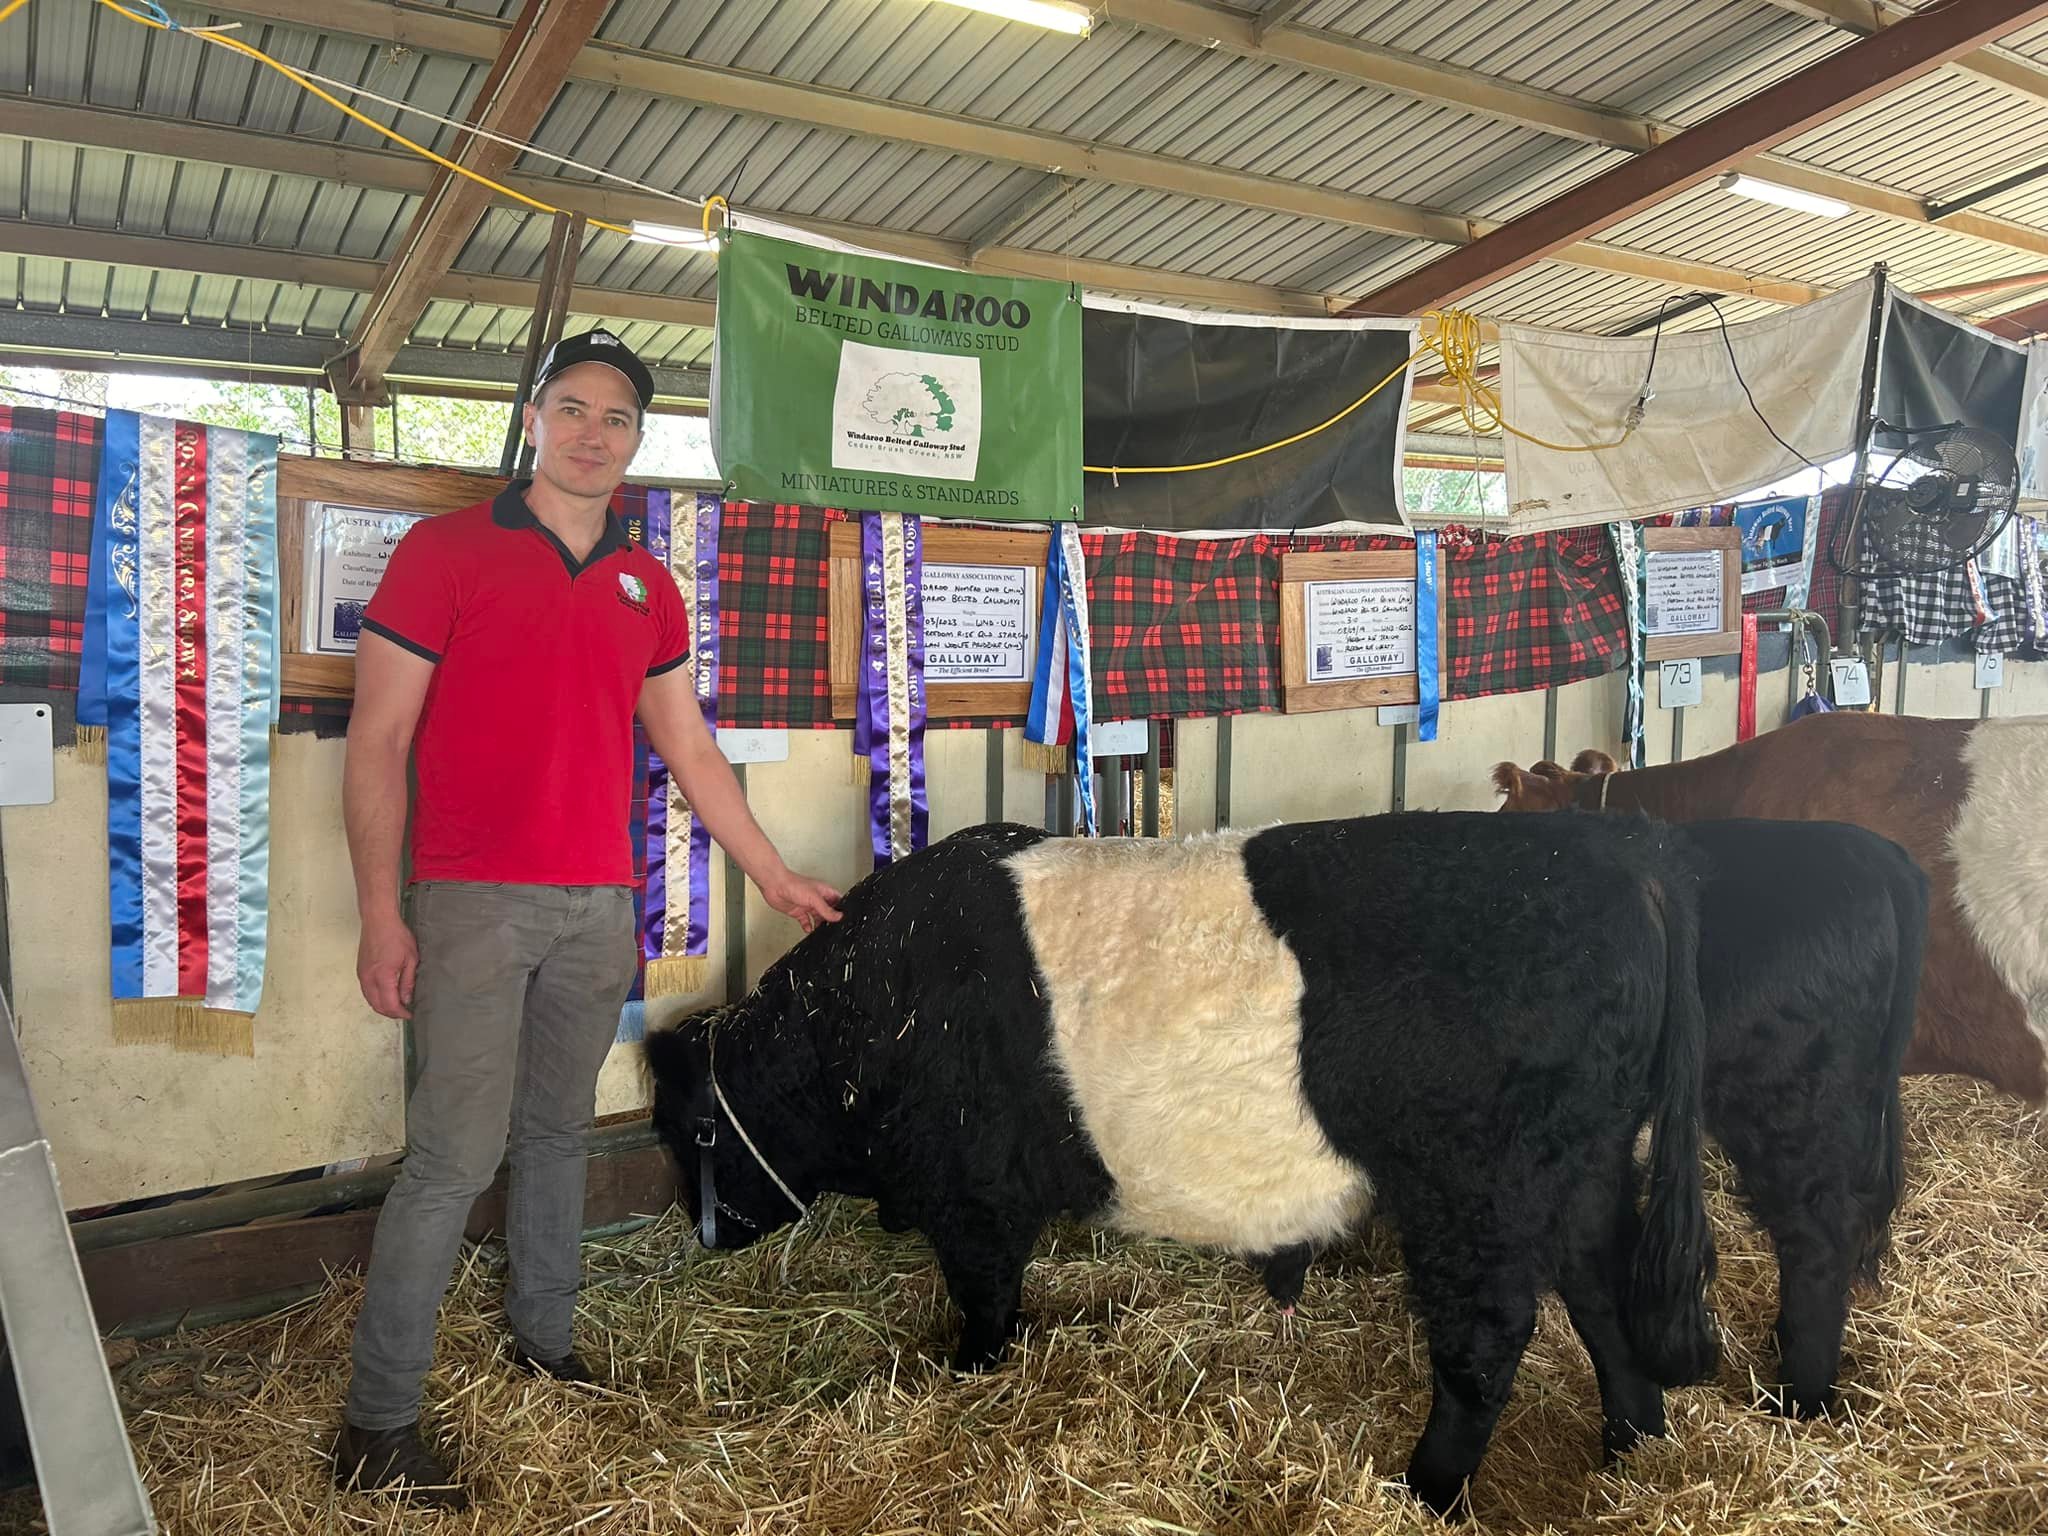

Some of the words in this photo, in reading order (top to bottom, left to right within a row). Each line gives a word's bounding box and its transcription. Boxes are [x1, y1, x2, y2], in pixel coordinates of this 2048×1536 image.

[786, 263, 1031, 330] WINDAROO
[795, 306, 873, 336] BELTED
[878, 322, 971, 348] GALLOWAYS
[975, 334, 1019, 351] STUD
[847, 431, 884, 442] Windaroo
[885, 436, 912, 446] Belted
[913, 439, 948, 452] Galloway
[848, 441, 873, 449] Cedar
[878, 445, 904, 453] Brush
[781, 472, 898, 497] MINIATURES
[901, 484, 913, 498] &
[916, 485, 1019, 505] STANDARDS
[629, 519, 641, 541] 202
[924, 571, 960, 579] GALLOWAY
[920, 584, 948, 592] DAROO
[178, 608, 198, 667] SHOW
[929, 654, 999, 663] GALLOWAY
[1350, 654, 1398, 664] GALLOWAY
[698, 649, 715, 697] SHOW
[1663, 662, 1691, 686] 73
[1835, 665, 1859, 685] 74
